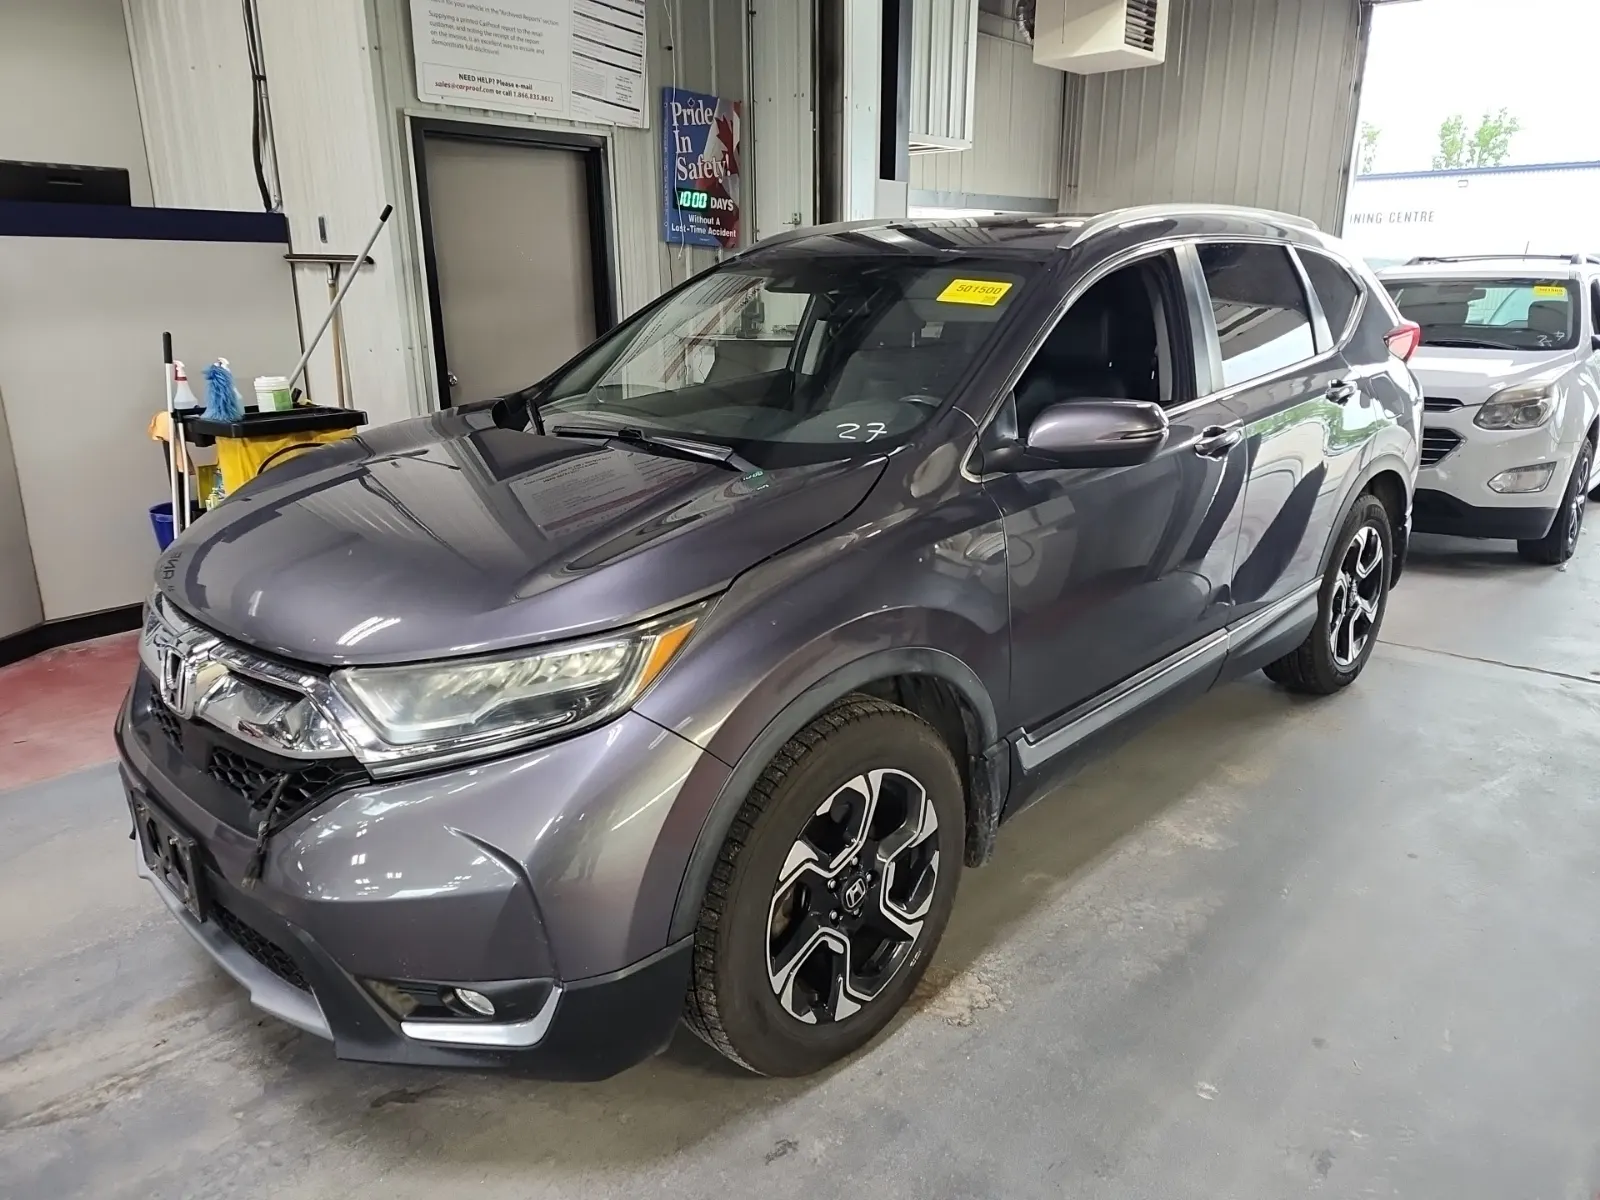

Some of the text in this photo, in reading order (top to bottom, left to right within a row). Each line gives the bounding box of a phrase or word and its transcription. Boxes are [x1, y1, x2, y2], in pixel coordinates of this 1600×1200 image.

[428, 10, 456, 22] Supplying
[435, 81, 495, 94] sales@carproof.com
[459, 73, 476, 82] NEED
[477, 76, 495, 85] HELP?
[496, 79, 515, 87] Please
[670, 99, 714, 127] Pride
[673, 129, 693, 154] In
[676, 153, 731, 184] Safety!
[710, 196, 734, 212] DAYS
[688, 213, 720, 226] Without A
[1389, 210, 1435, 224] CENTRE
[671, 222, 736, 238] Lost-Time Accident
[956, 284, 1003, 295] 501500
[836, 422, 888, 443] 27
